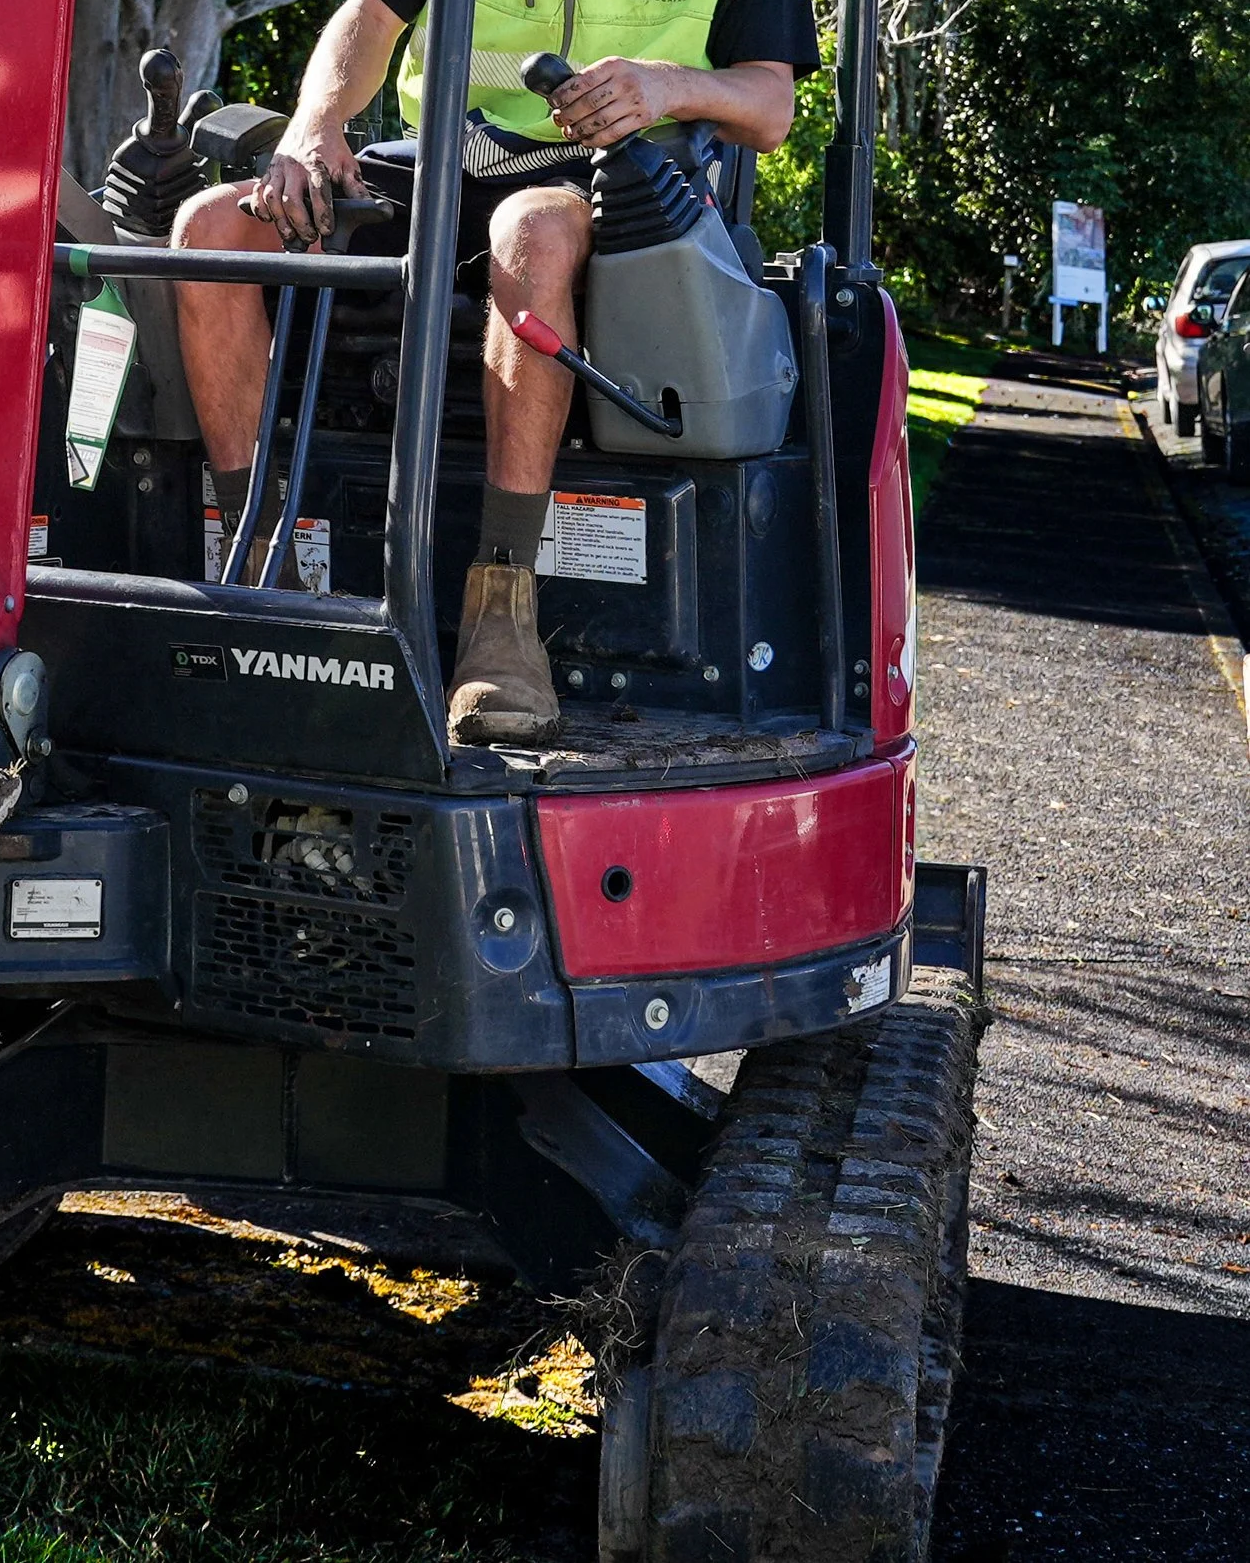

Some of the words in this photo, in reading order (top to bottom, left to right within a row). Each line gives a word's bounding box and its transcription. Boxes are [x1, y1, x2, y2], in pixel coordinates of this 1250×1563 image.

[583, 496, 620, 506] WARNING
[191, 655, 217, 665] TDX
[231, 647, 395, 690] YANMAR
